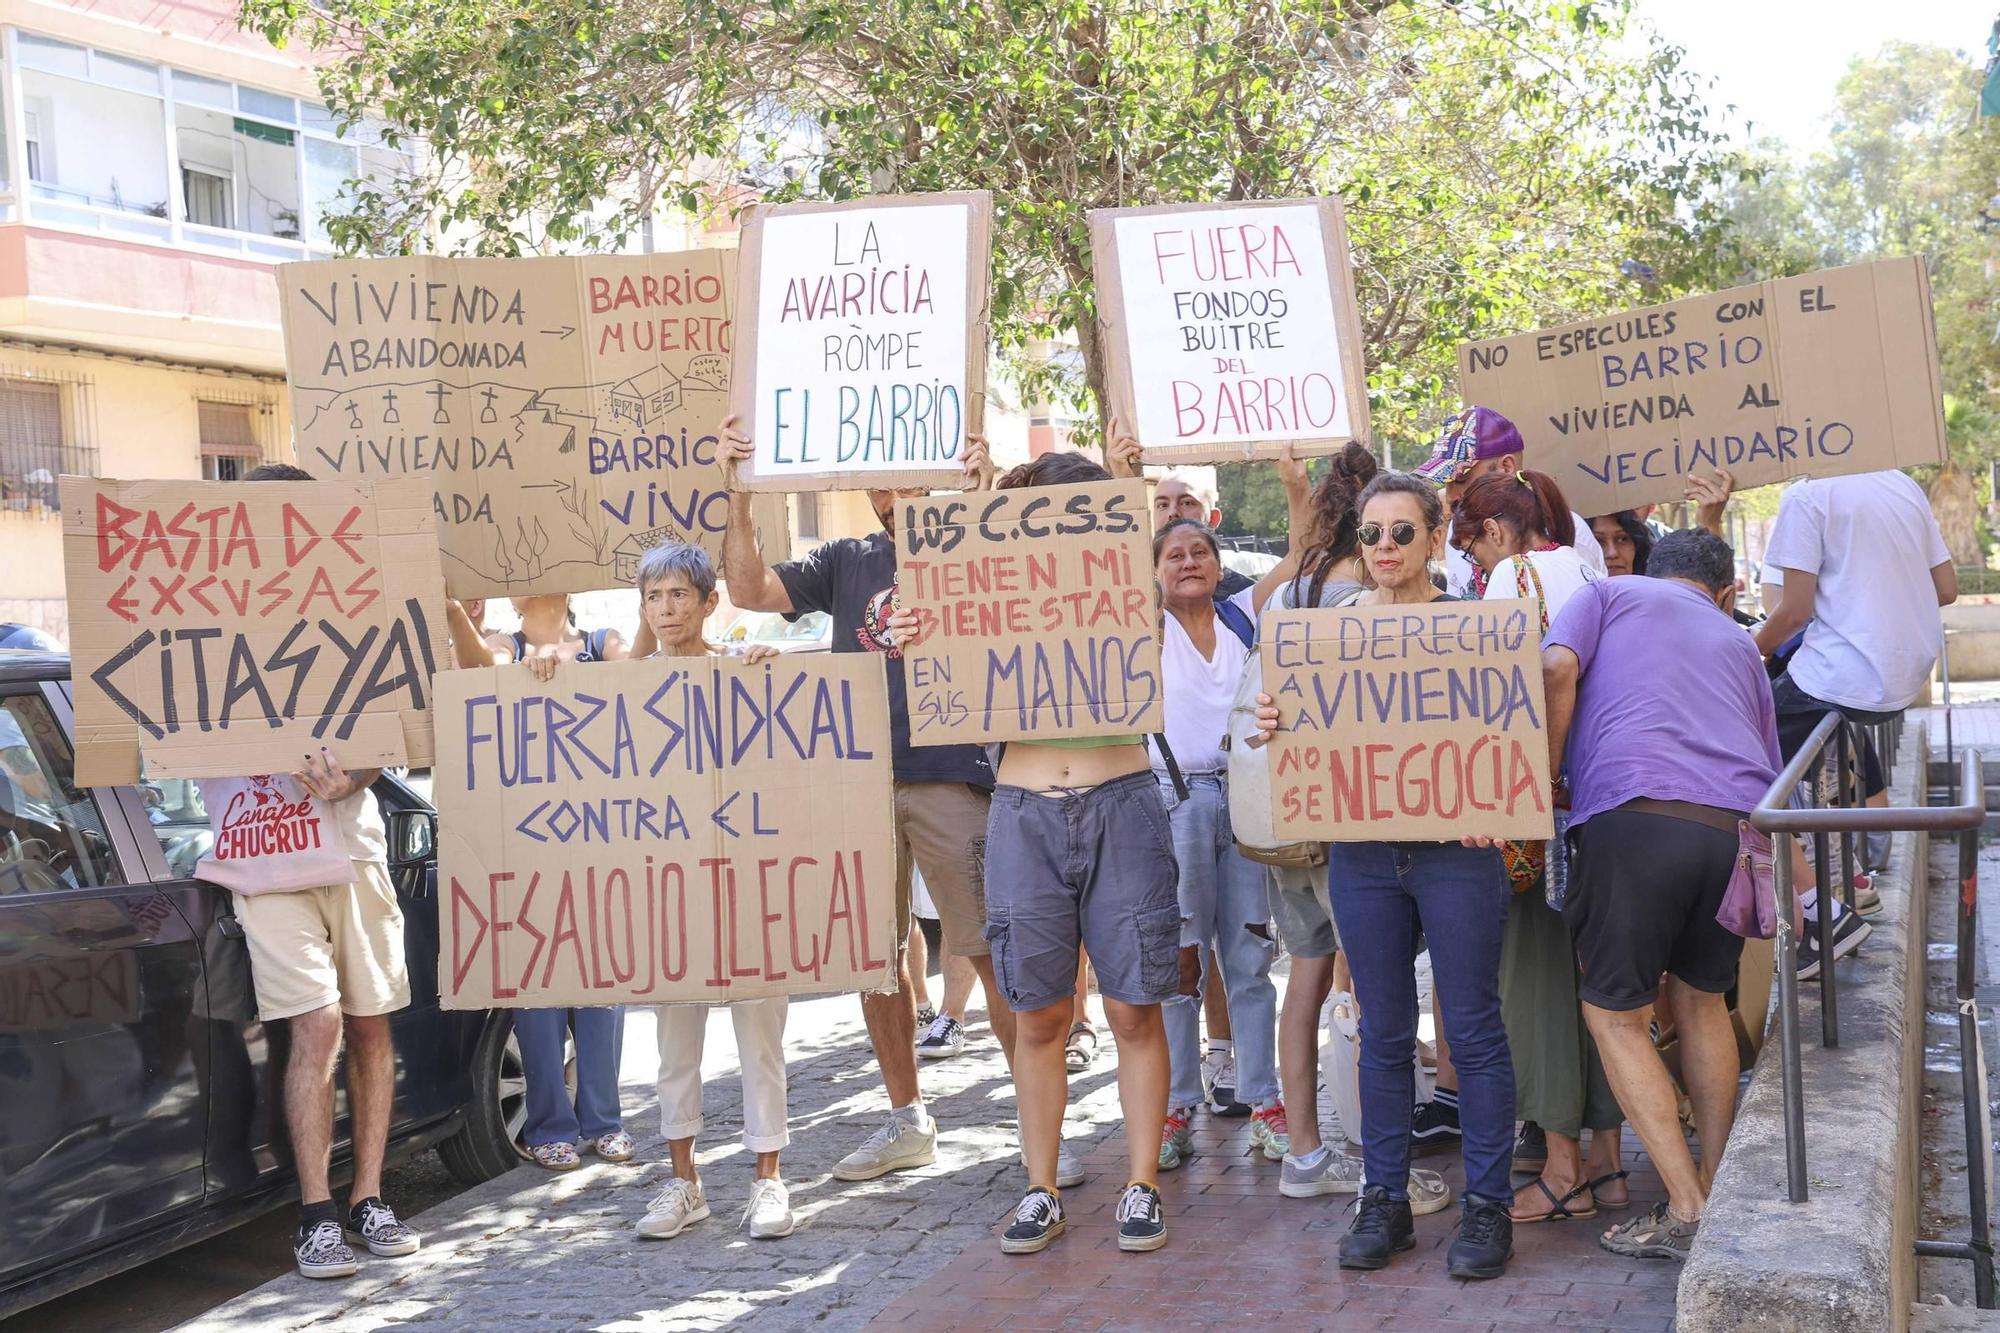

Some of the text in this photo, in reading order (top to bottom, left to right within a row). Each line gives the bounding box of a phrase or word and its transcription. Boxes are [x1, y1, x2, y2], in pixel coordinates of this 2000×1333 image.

[834, 221, 881, 266] LA
[1153, 224, 1302, 285] FUERA
[300, 273, 526, 326] VIVIENDA
[589, 269, 721, 313] BARRIO
[781, 264, 934, 323] AVARICIA
[1173, 288, 1288, 320] FONDOS
[1180, 319, 1285, 352] BUITRE
[1469, 285, 1836, 374] NO ESPECULES CON EL
[322, 340, 527, 376] ABANDONADA
[1212, 357, 1256, 375] DEL
[1603, 332, 1763, 388] BARRIO
[773, 378, 961, 464] EL BARRIO
[1172, 373, 1335, 437] BARRIO
[1549, 382, 1780, 435] VIVIENDA AL
[316, 428, 514, 473] VIVIENDA
[1577, 418, 1854, 485] VECINDARIO
[96, 492, 365, 573] BASTA DE
[432, 491, 494, 524] ADA
[906, 494, 1139, 555] LOS C.C.S.S.
[106, 566, 381, 624] EXCUSAS
[903, 542, 1132, 600] TIENEN MI
[909, 588, 1149, 646] BIENESTAR
[1275, 608, 1527, 668] EL DERECHO
[913, 656, 951, 688] EN
[983, 635, 1157, 732] MANOS
[1279, 673, 1303, 698] A
[1312, 664, 1541, 732] VIVIENDA
[465, 664, 874, 791] FUERZA SINDICAL
[917, 690, 969, 732] SUS
[1276, 745, 1321, 777] NO
[1329, 734, 1546, 824] NEGOCIA
[222, 792, 313, 837] Canapé
[515, 791, 779, 844] CONTRA EL
[1281, 784, 1323, 824] SE
[215, 818, 321, 861] CHUCRUT
[450, 850, 888, 999] DESALOJO ILEGAL
